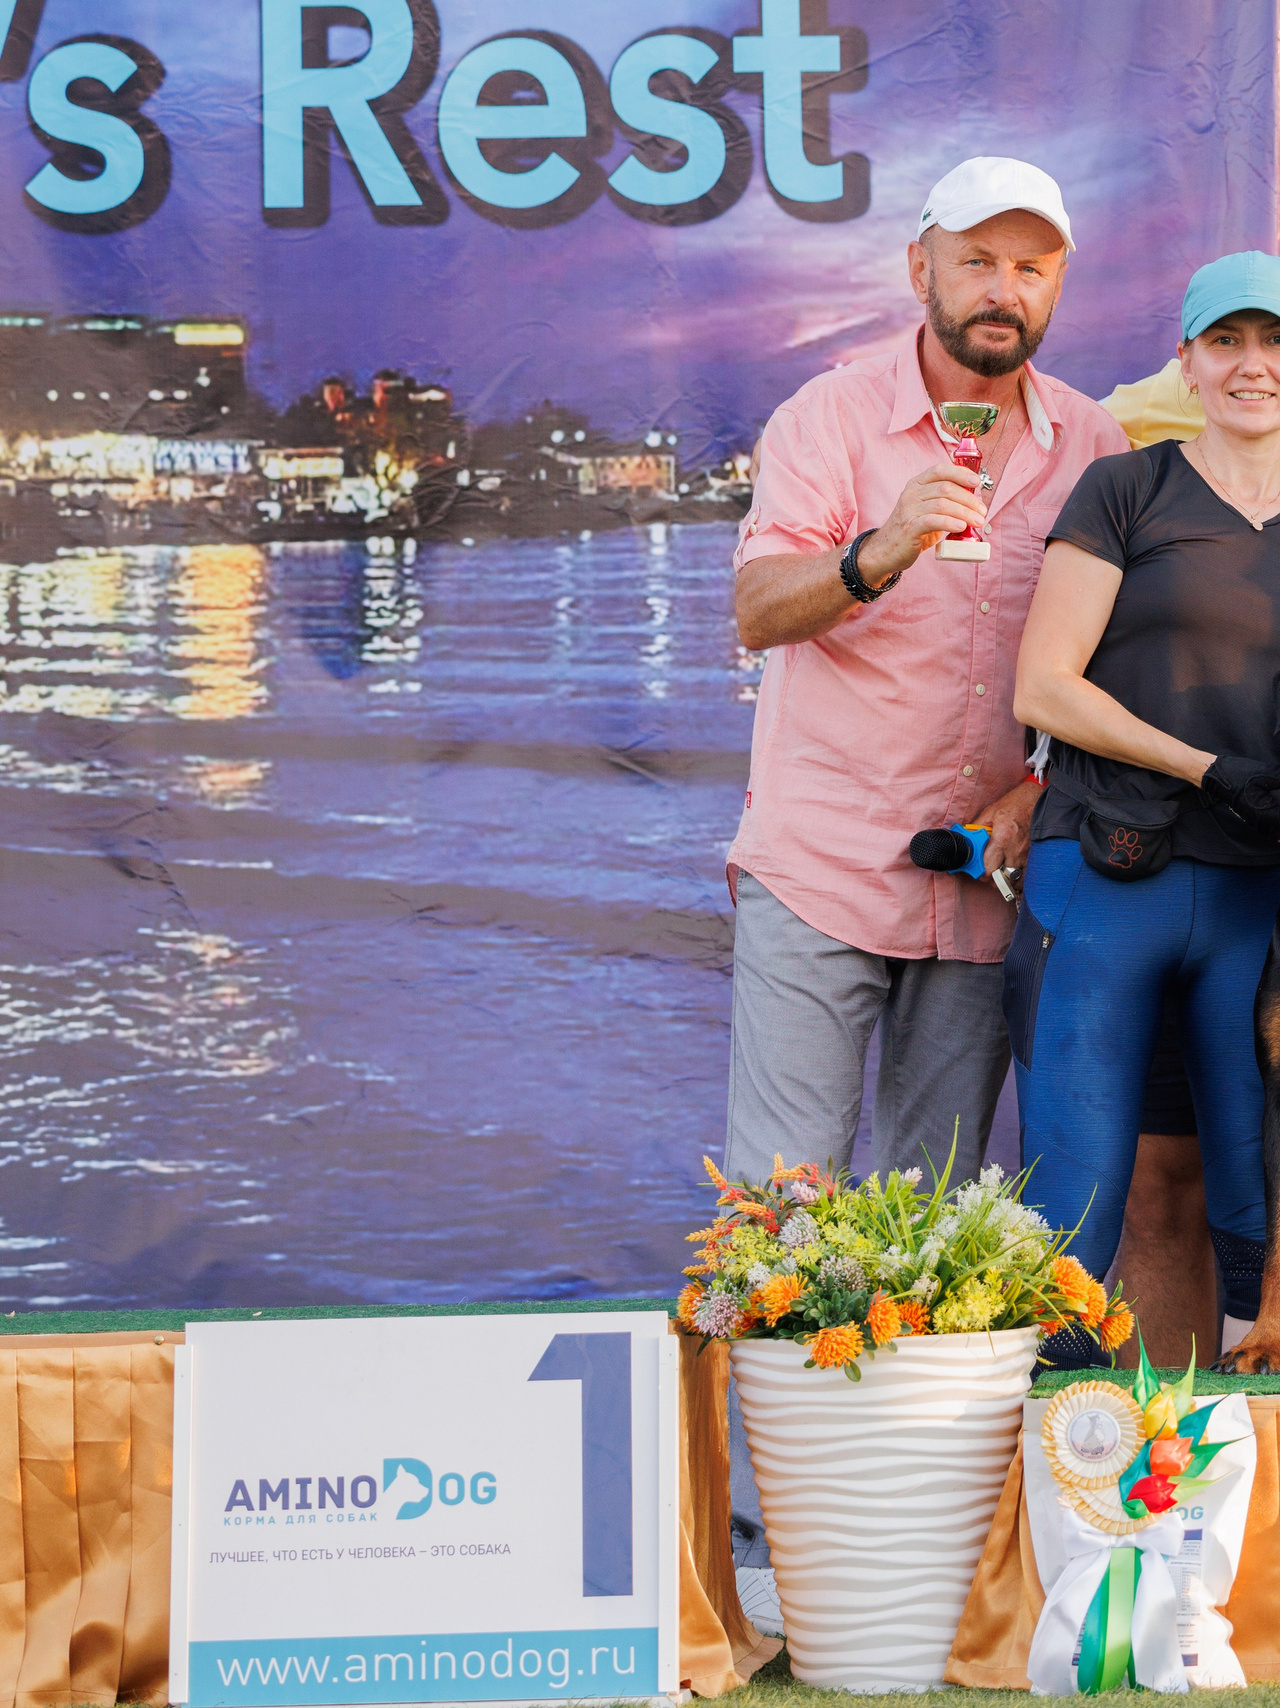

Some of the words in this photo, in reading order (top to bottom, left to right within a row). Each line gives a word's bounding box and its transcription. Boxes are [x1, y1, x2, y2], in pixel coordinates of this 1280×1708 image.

[261, 0, 844, 209] Rest
[526, 1331, 634, 1598] 1
[223, 1514, 276, 1526] КОРМА
[285, 1514, 316, 1525] ДЛЯ
[325, 1512, 378, 1523] СОБАК
[209, 1550, 269, 1564] ЛУЧШЕЕ,
[272, 1549, 298, 1562] ЧТО
[301, 1548, 334, 1561] ЕСТЬ
[335, 1547, 345, 1560] У
[348, 1545, 417, 1559] ЧЕЛОВЕКА
[430, 1544, 456, 1557] ЭТО
[459, 1543, 512, 1556] СОБАКА
[216, 1637, 637, 1690] www.aminodog.ru
